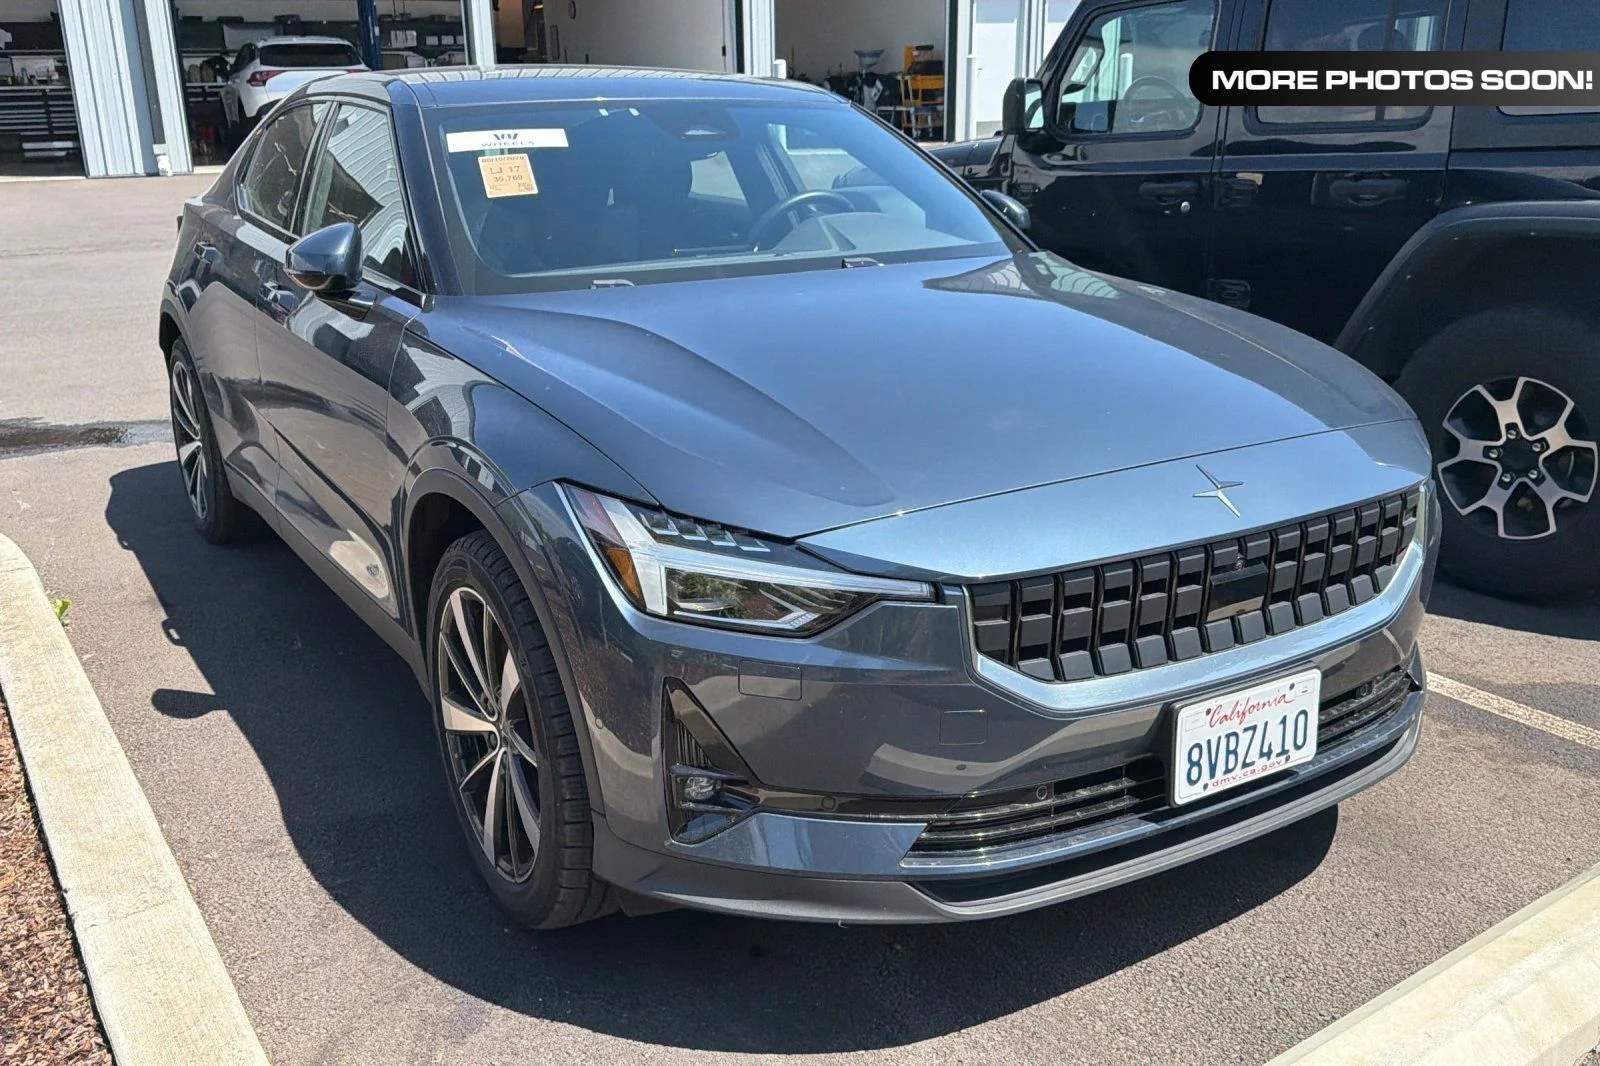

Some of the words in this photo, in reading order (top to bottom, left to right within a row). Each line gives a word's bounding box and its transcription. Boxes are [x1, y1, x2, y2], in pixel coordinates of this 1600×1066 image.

[489, 166, 503, 175] LJ
[509, 165, 520, 173] 17
[1208, 693, 1295, 728] California
[1186, 708, 1309, 787] 8VBZ410
[1211, 758, 1283, 788] dmv.ca.gov
